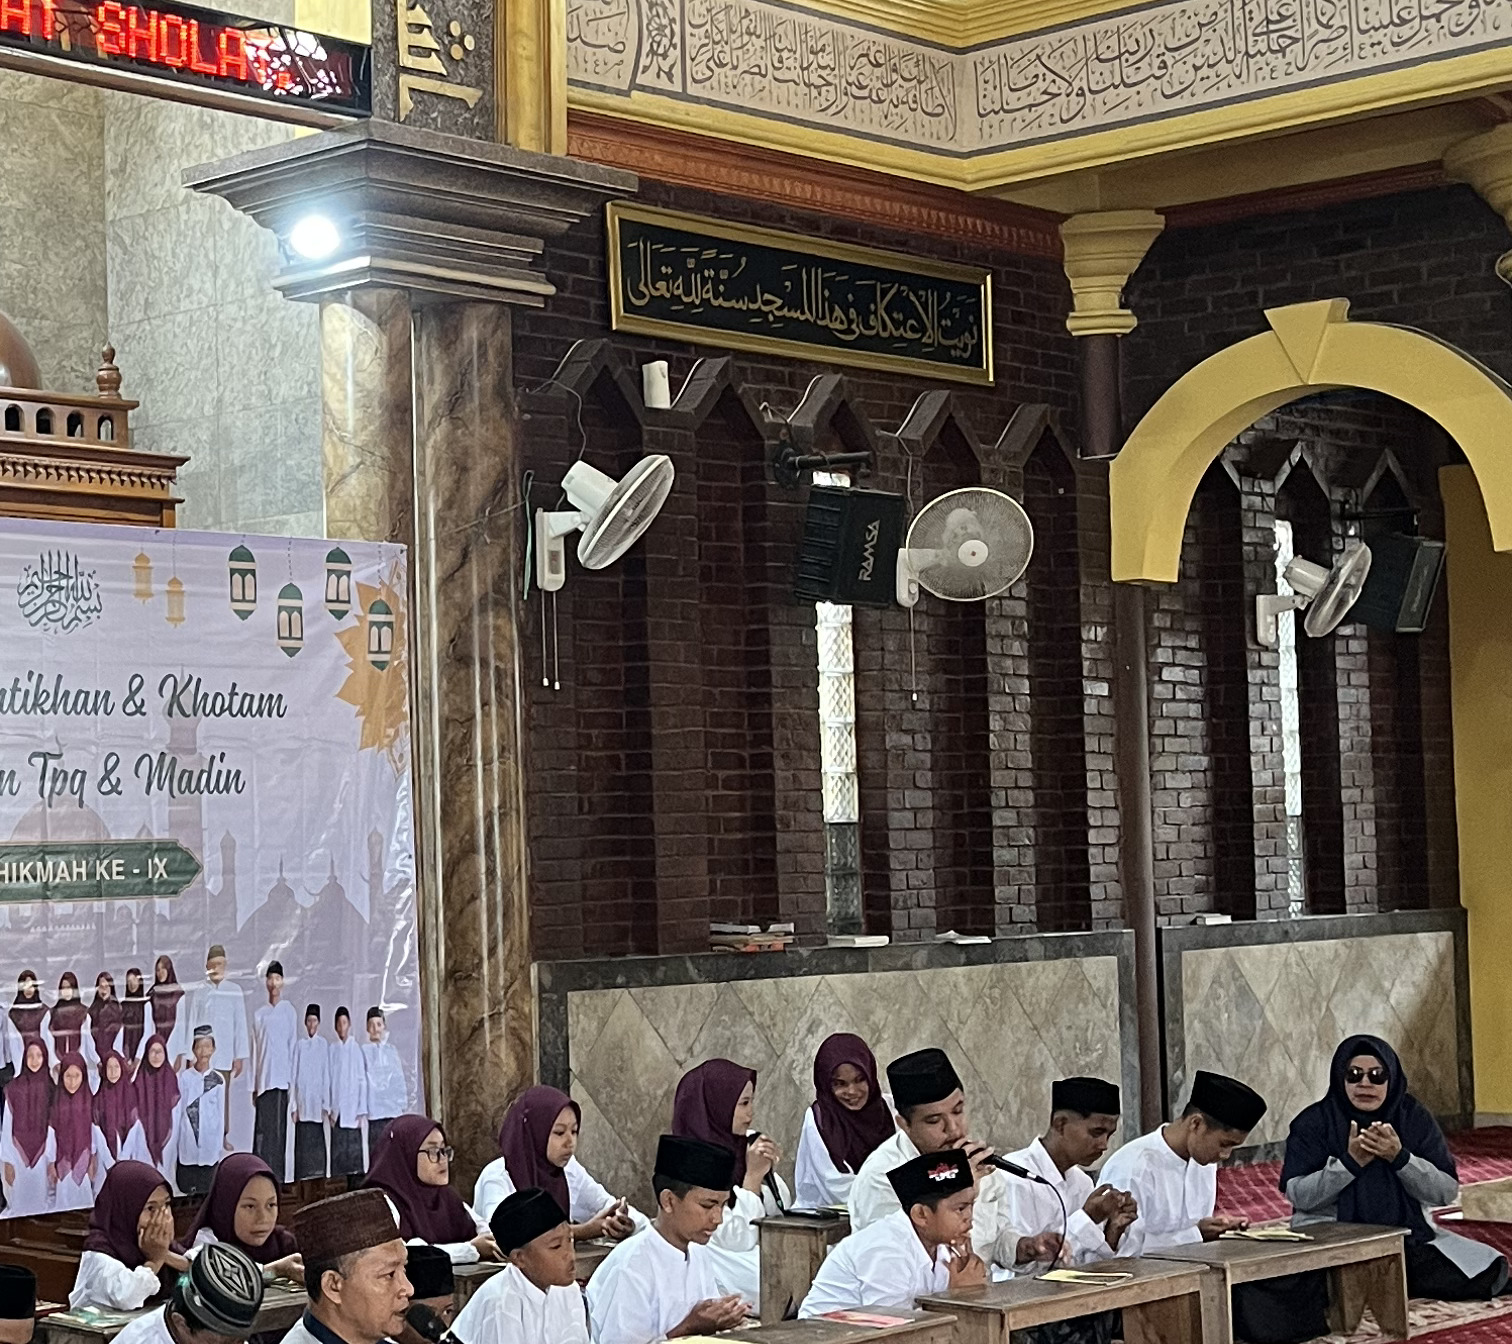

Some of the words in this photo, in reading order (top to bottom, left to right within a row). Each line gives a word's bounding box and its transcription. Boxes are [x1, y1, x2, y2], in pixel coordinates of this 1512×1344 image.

[857, 519, 881, 581] RAMSA
[121, 673, 147, 718] &
[158, 673, 288, 719] Khotam
[27, 750, 86, 810] Tpq
[96, 751, 123, 797] &
[133, 752, 247, 797] Madin
[95, 858, 125, 881] KE
[147, 857, 169, 880] IX
